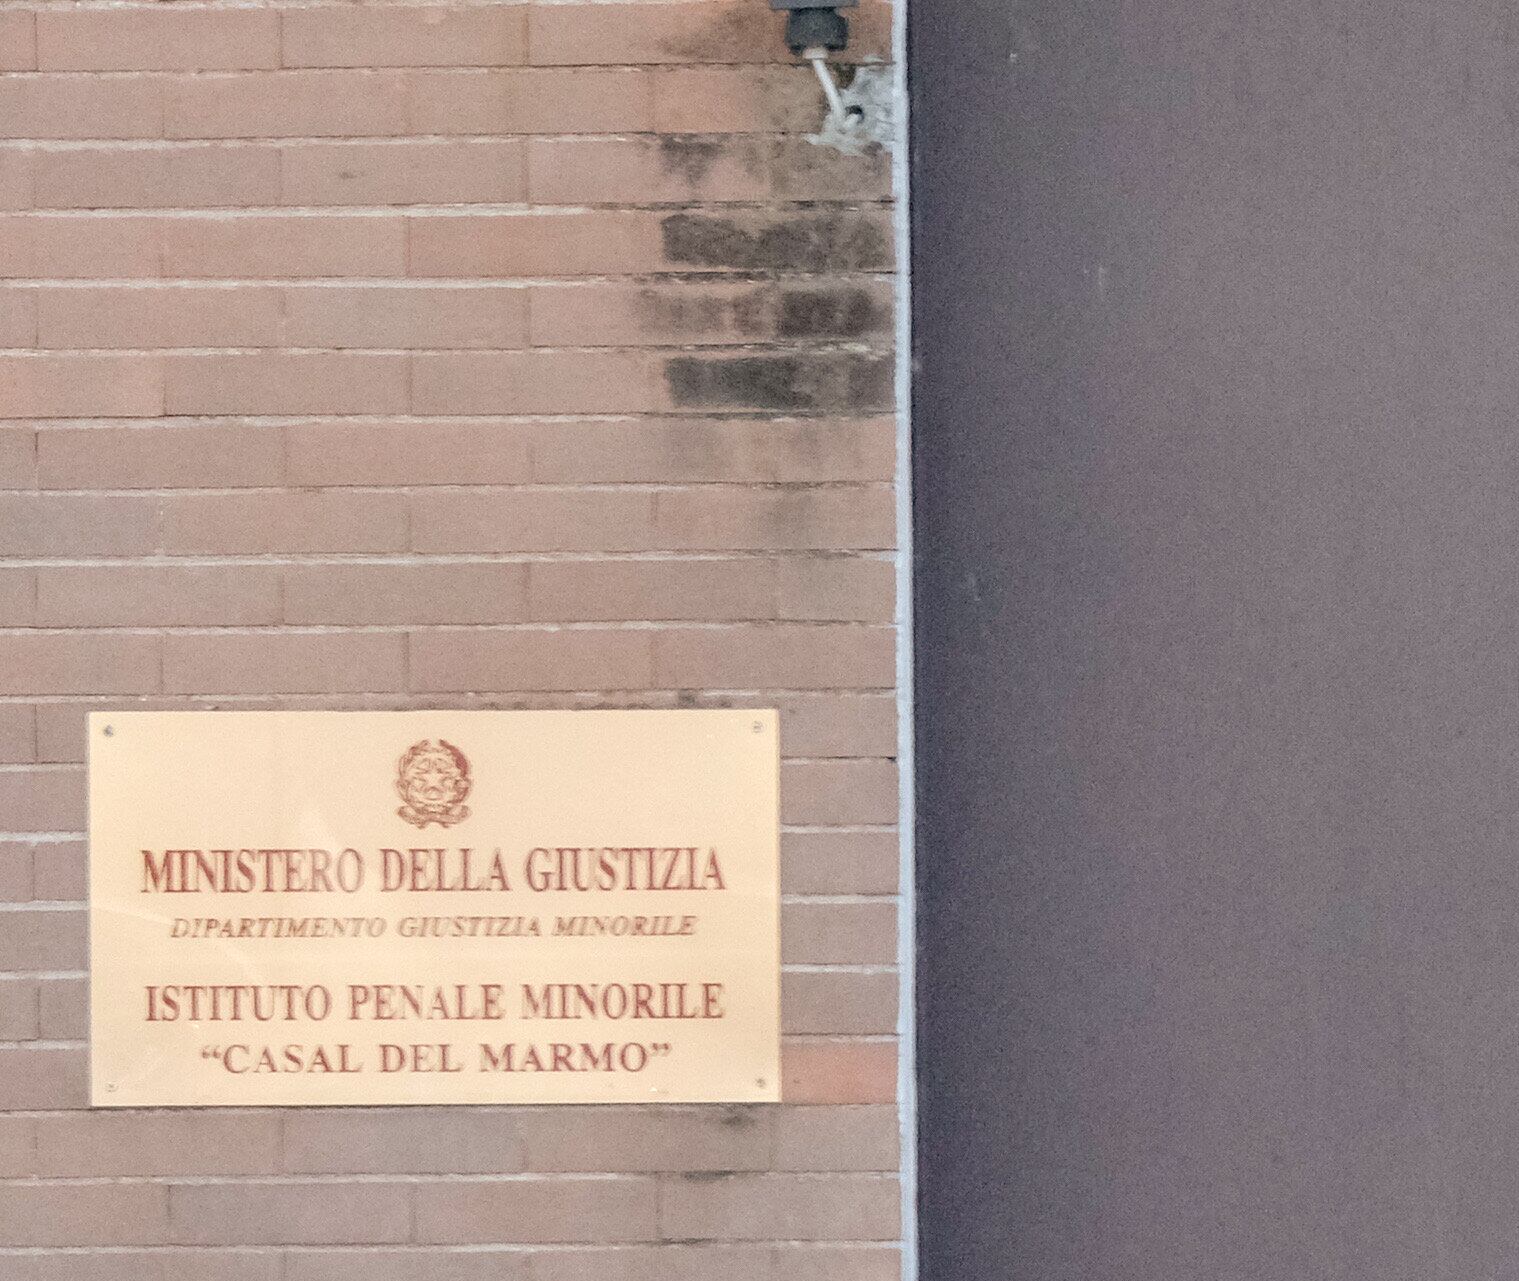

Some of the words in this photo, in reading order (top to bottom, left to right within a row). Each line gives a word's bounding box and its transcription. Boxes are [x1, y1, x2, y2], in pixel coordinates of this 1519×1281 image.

[140, 848, 364, 893] MINISTERO
[379, 847, 511, 893] DELLA
[523, 845, 727, 892] GIUSTIZIA
[170, 917, 386, 938] DIPARTIMENTO
[398, 916, 543, 938] GIUSTIZIA
[554, 914, 698, 936] MINORILE
[144, 984, 333, 1021] ISTITUTO
[347, 984, 506, 1022] PENALE
[519, 982, 725, 1021] MINORILE
[378, 1044, 462, 1074] DEL
